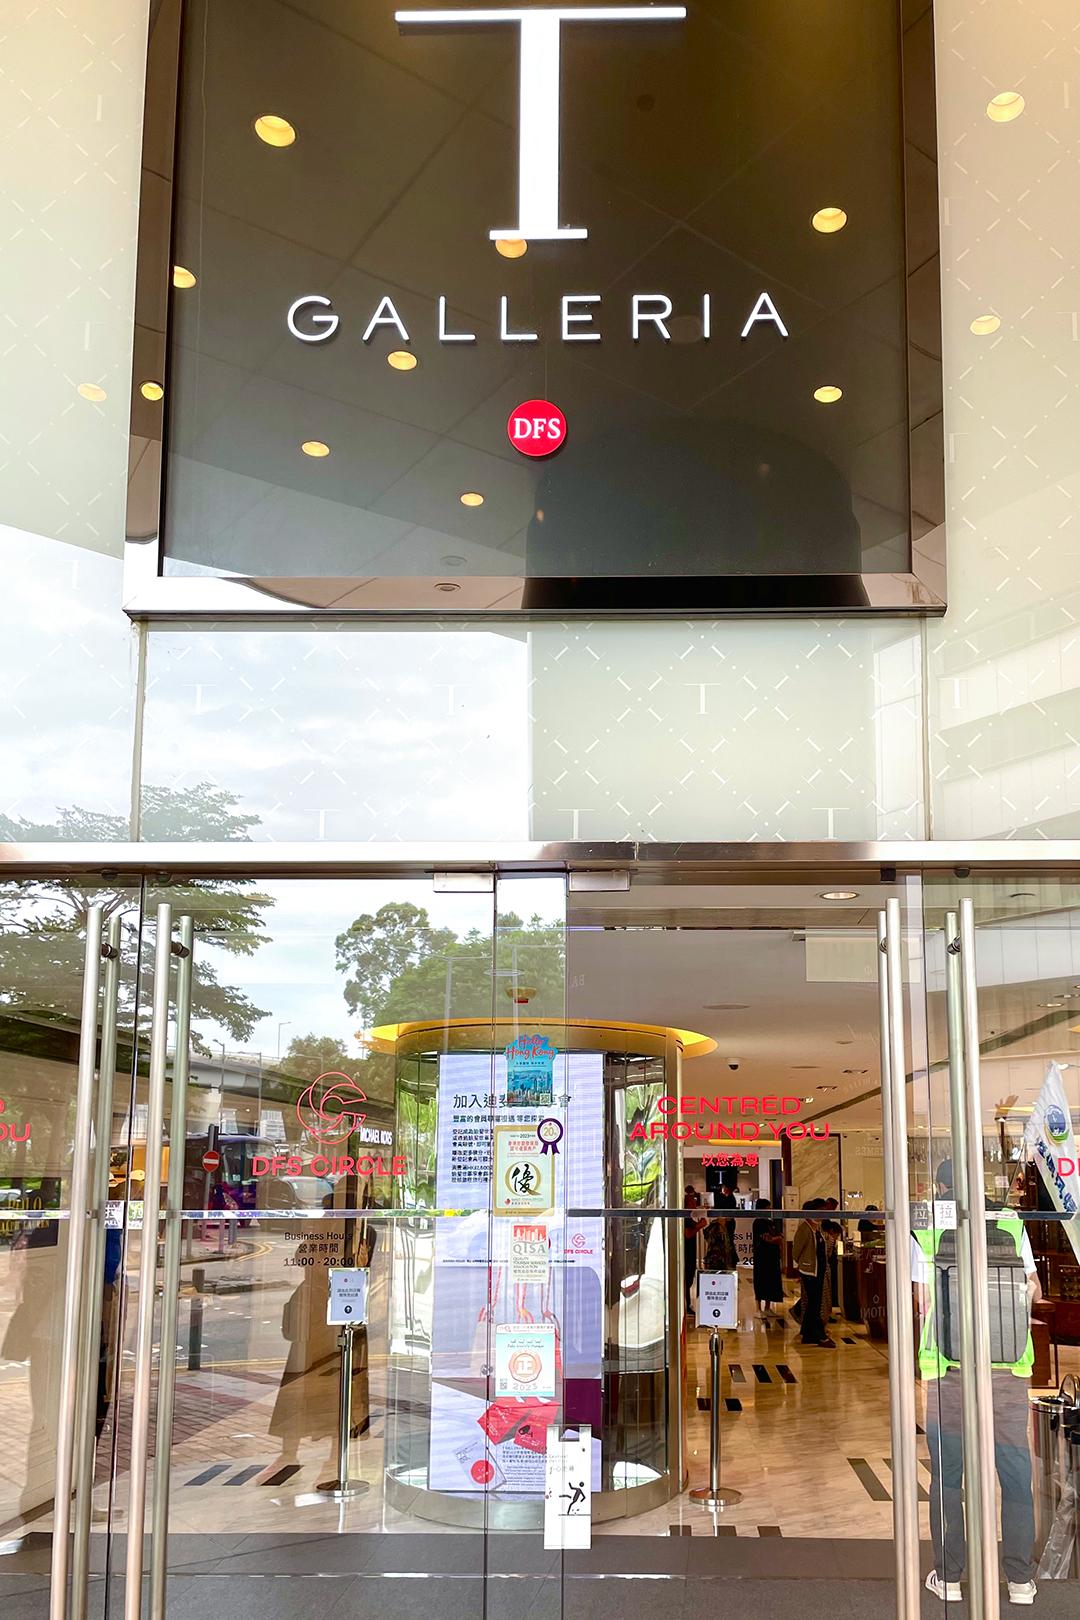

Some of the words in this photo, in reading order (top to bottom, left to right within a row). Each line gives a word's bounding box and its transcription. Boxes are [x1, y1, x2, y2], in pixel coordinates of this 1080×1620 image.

[395, 7, 687, 240] T
[286, 293, 789, 342] GALLERIA
[513, 417, 562, 440] DFS
[505, 1045, 530, 1060] Hong
[531, 1045, 555, 1060] Kong
[657, 1096, 801, 1115] CENTRED
[629, 1121, 760, 1141] AROUND
[768, 1121, 831, 1141] YOU
[252, 1155, 303, 1177] DFS
[310, 1155, 408, 1177] CIRCLE
[701, 1153, 759, 1168] 以您為尊
[284, 1232, 324, 1241] Business
[298, 1243, 339, 1254] 營業時間
[512, 1242, 546, 1255] QTSA
[283, 1257, 315, 1266] 11:00
[323, 1257, 354, 1266] 20:00
